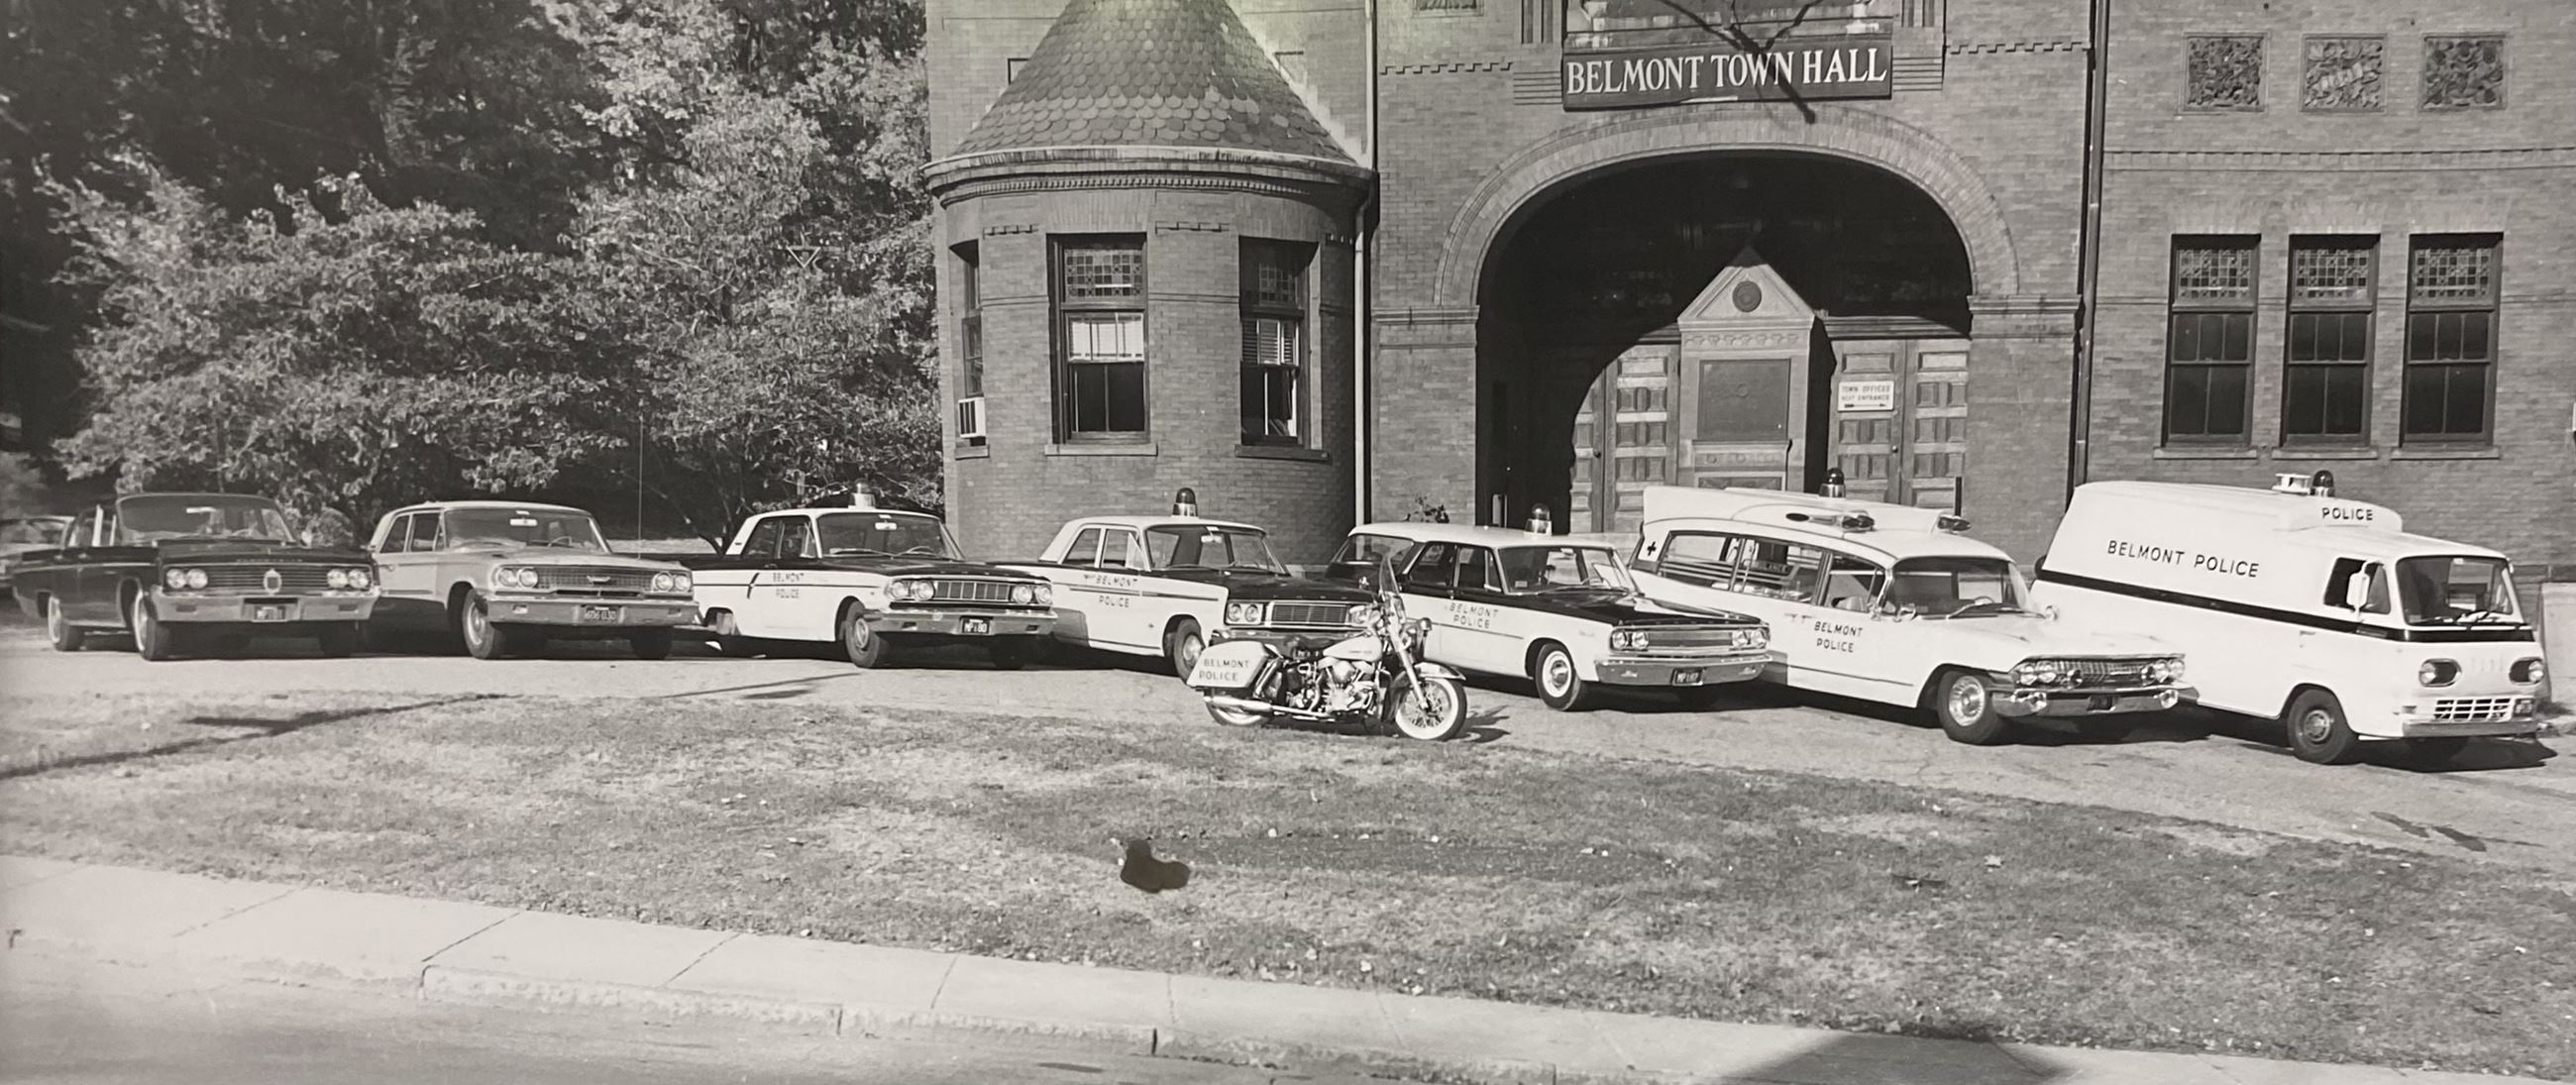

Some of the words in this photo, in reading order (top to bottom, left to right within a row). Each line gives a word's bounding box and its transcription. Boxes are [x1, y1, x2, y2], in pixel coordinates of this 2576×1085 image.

[1566, 56, 1704, 94] BELMONT
[1711, 52, 1795, 87] TOWN
[1802, 49, 1887, 83] HALL
[2321, 506, 2374, 521] POLICE
[2107, 540, 2186, 565] BELMONT
[2194, 554, 2260, 578] POLICE
[1096, 575, 1138, 588] BELMONT
[1099, 595, 1129, 608] POLICE
[1449, 601, 1499, 618] BELMONT
[1453, 614, 1490, 629] POLICE
[1814, 620, 1864, 637] BELMONT
[1816, 637, 1855, 654] POLICE
[1203, 658, 1249, 668] BELMONT
[1198, 670, 1237, 682] POLICE
